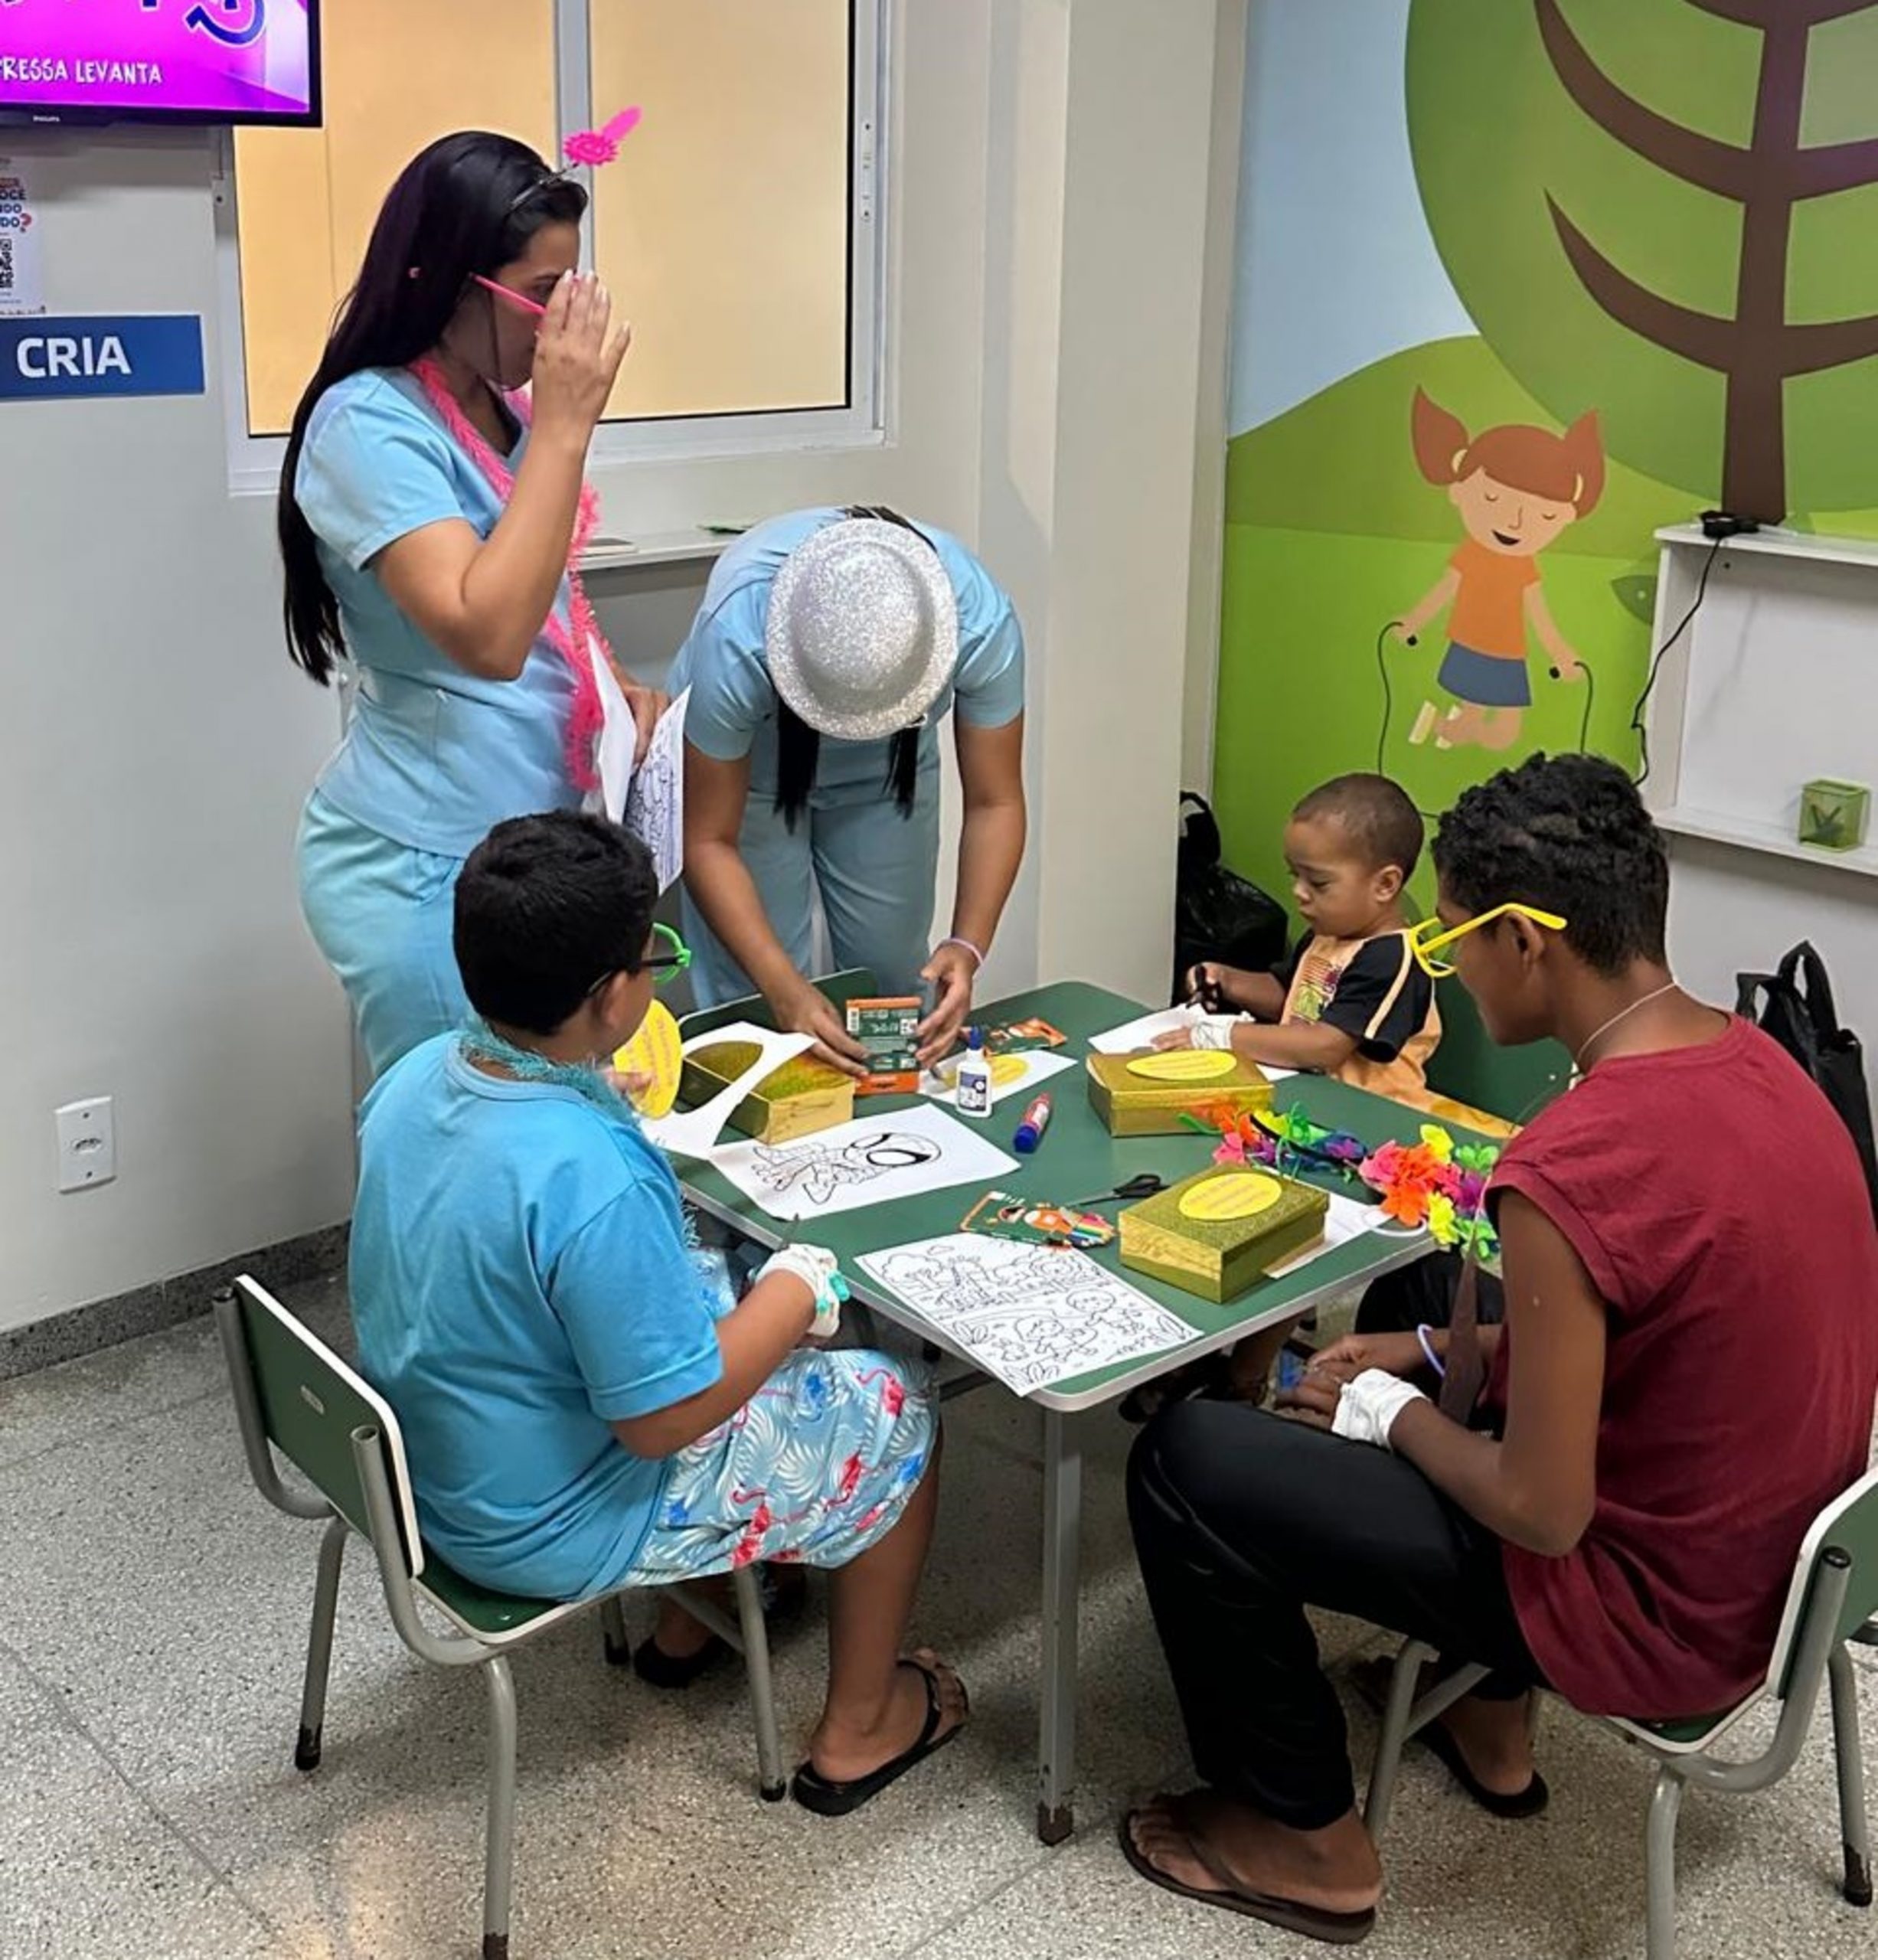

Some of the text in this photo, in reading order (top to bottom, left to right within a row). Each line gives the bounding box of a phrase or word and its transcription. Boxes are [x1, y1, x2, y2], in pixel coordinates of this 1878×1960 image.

[0, 57, 163, 84] RESSA LEVANTA
[17, 336, 132, 378] CRIA
